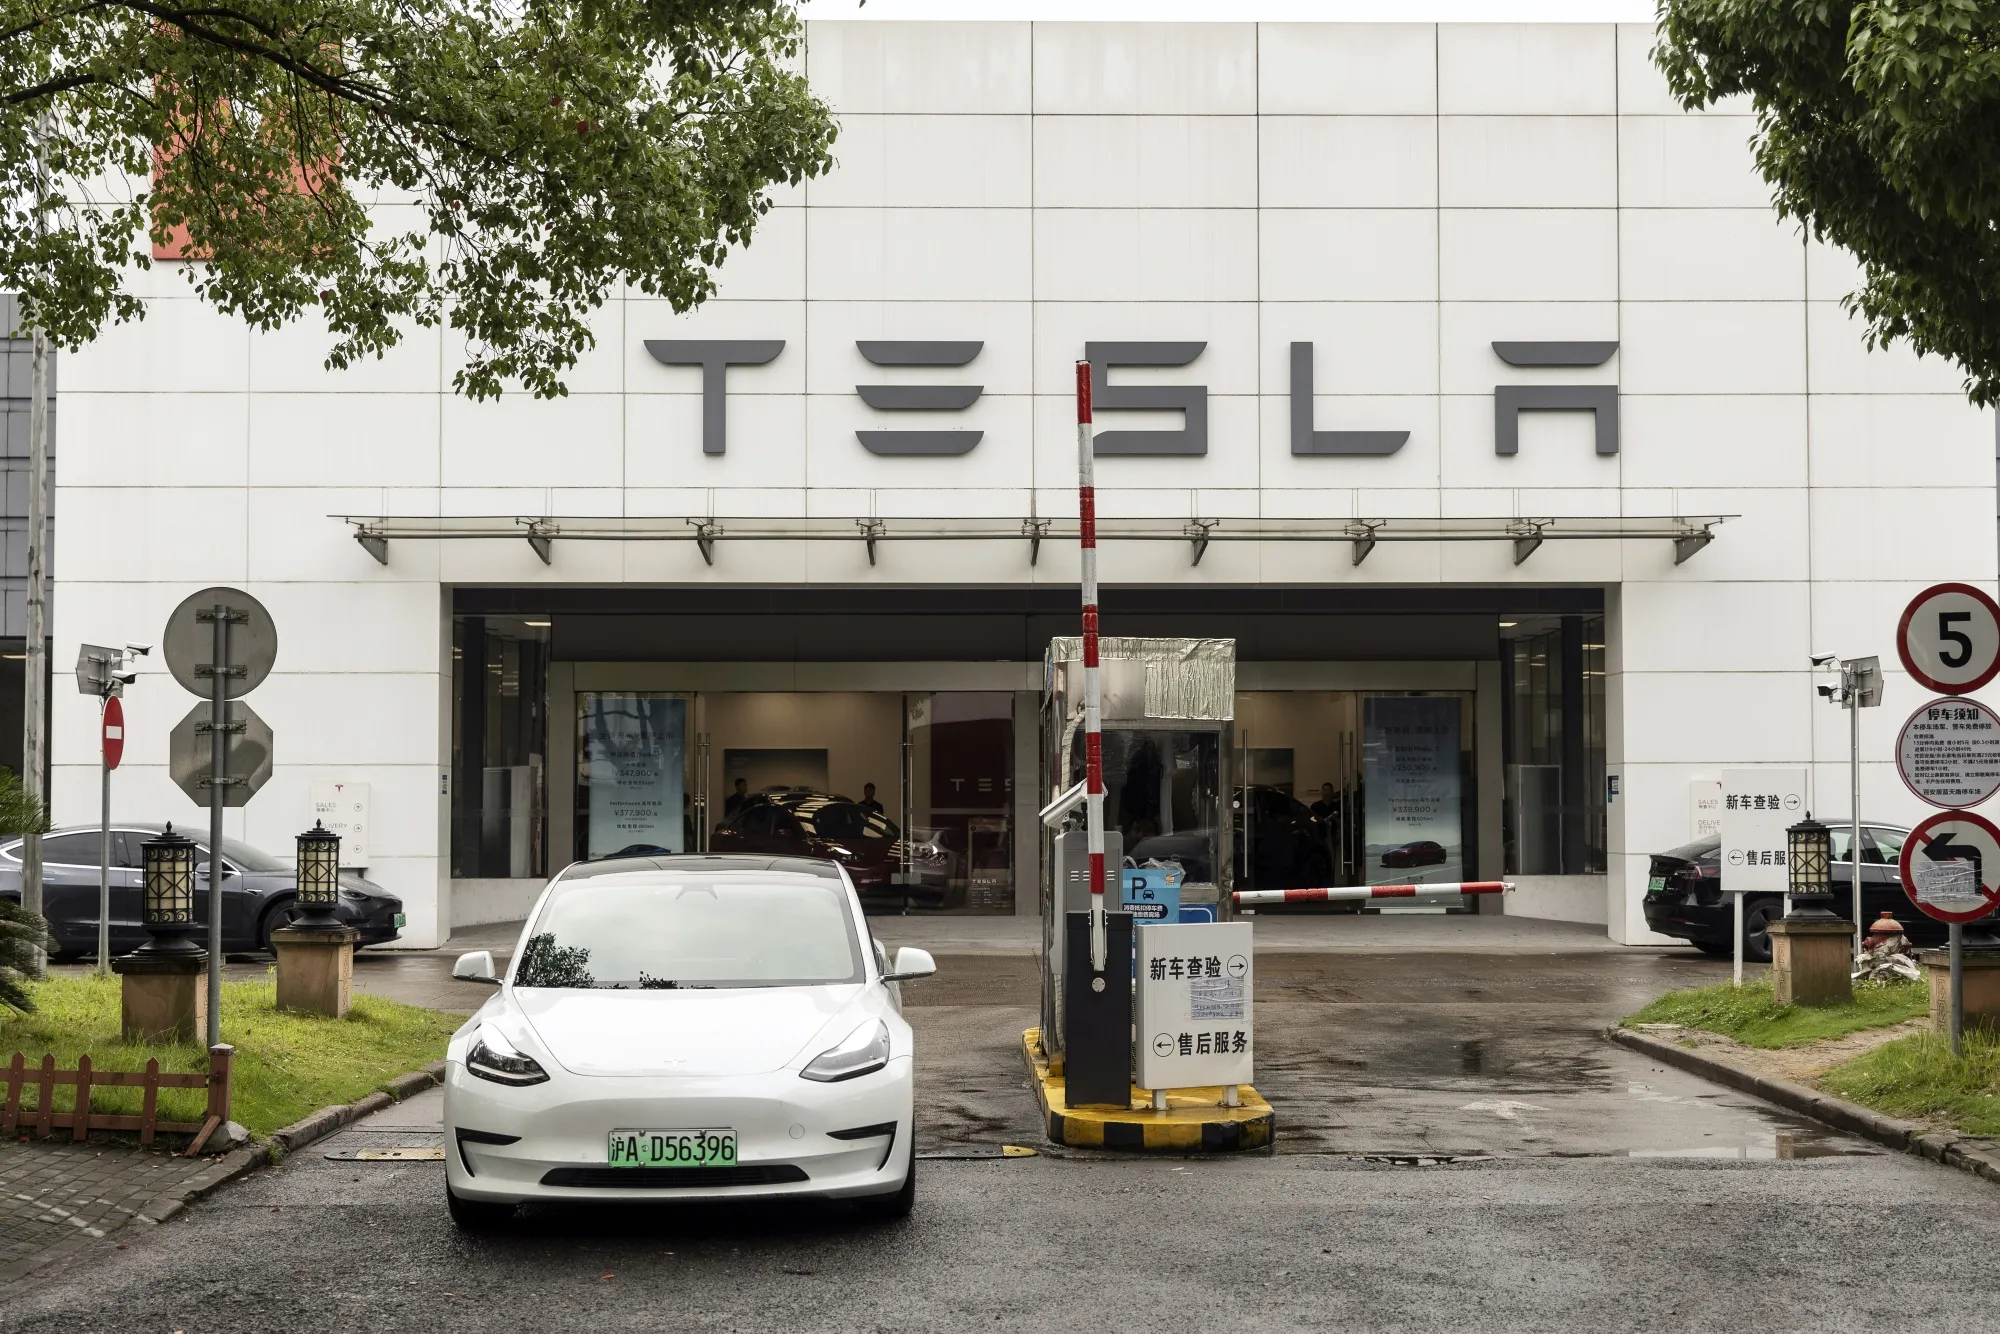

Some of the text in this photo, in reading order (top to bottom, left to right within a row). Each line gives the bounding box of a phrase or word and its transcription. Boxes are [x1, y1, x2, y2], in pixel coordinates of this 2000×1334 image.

[643, 340, 1618, 456] TESLA
[1938, 611, 1972, 668] 5
[1928, 708, 1979, 721] 停车须知
[1726, 794, 1780, 810] 新车查验
[1923, 788, 1982, 796] 百安居蓝天路停车场
[614, 809, 652, 817] ¥377,900
[1392, 806, 1431, 814] ¥339,900
[1746, 850, 1786, 865] 售后服
[1131, 876, 1148, 900] P
[1150, 955, 1222, 981] 新车查验
[1177, 1030, 1248, 1056] 售后服务
[611, 1135, 734, 1162] 沪A D56396
